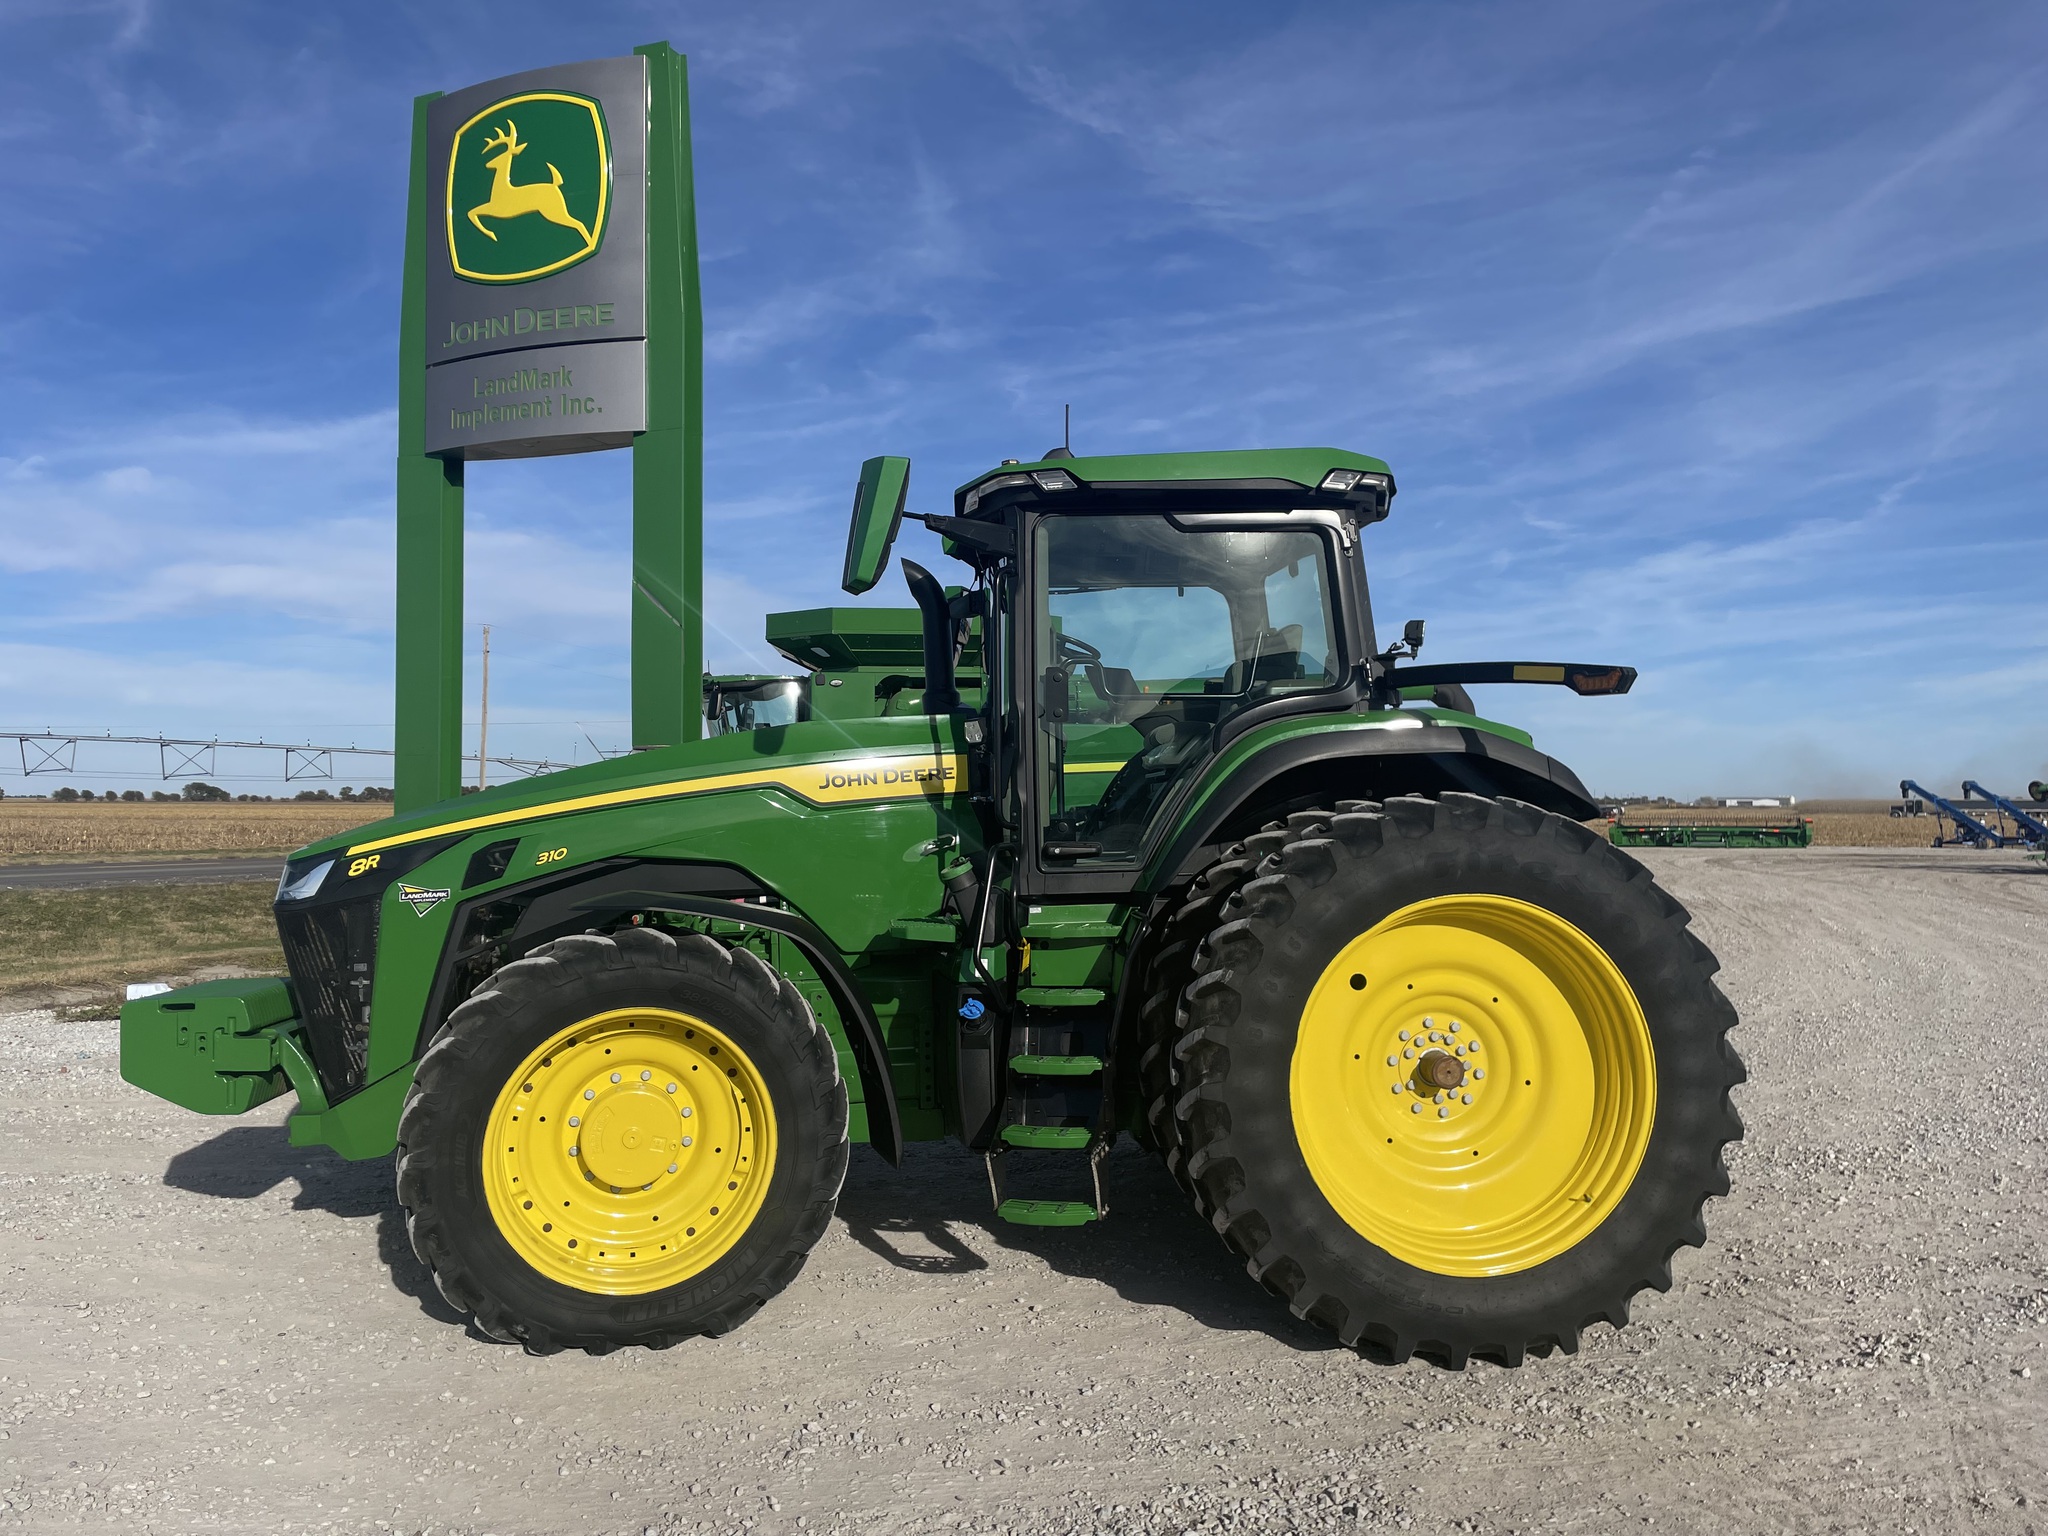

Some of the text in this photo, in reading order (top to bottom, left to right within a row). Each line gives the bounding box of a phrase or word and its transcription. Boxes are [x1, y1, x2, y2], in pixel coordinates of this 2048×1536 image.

[443, 303, 615, 348] JOHN DEERE
[473, 365, 573, 398] LandMark
[451, 394, 603, 431] Implement Inc.
[819, 767, 955, 789] JOHN DEERE
[348, 855, 380, 877] 8R
[535, 847, 568, 865] 310
[401, 892, 448, 900] LANDMARK
[624, 1247, 758, 1323] MICHELIN
